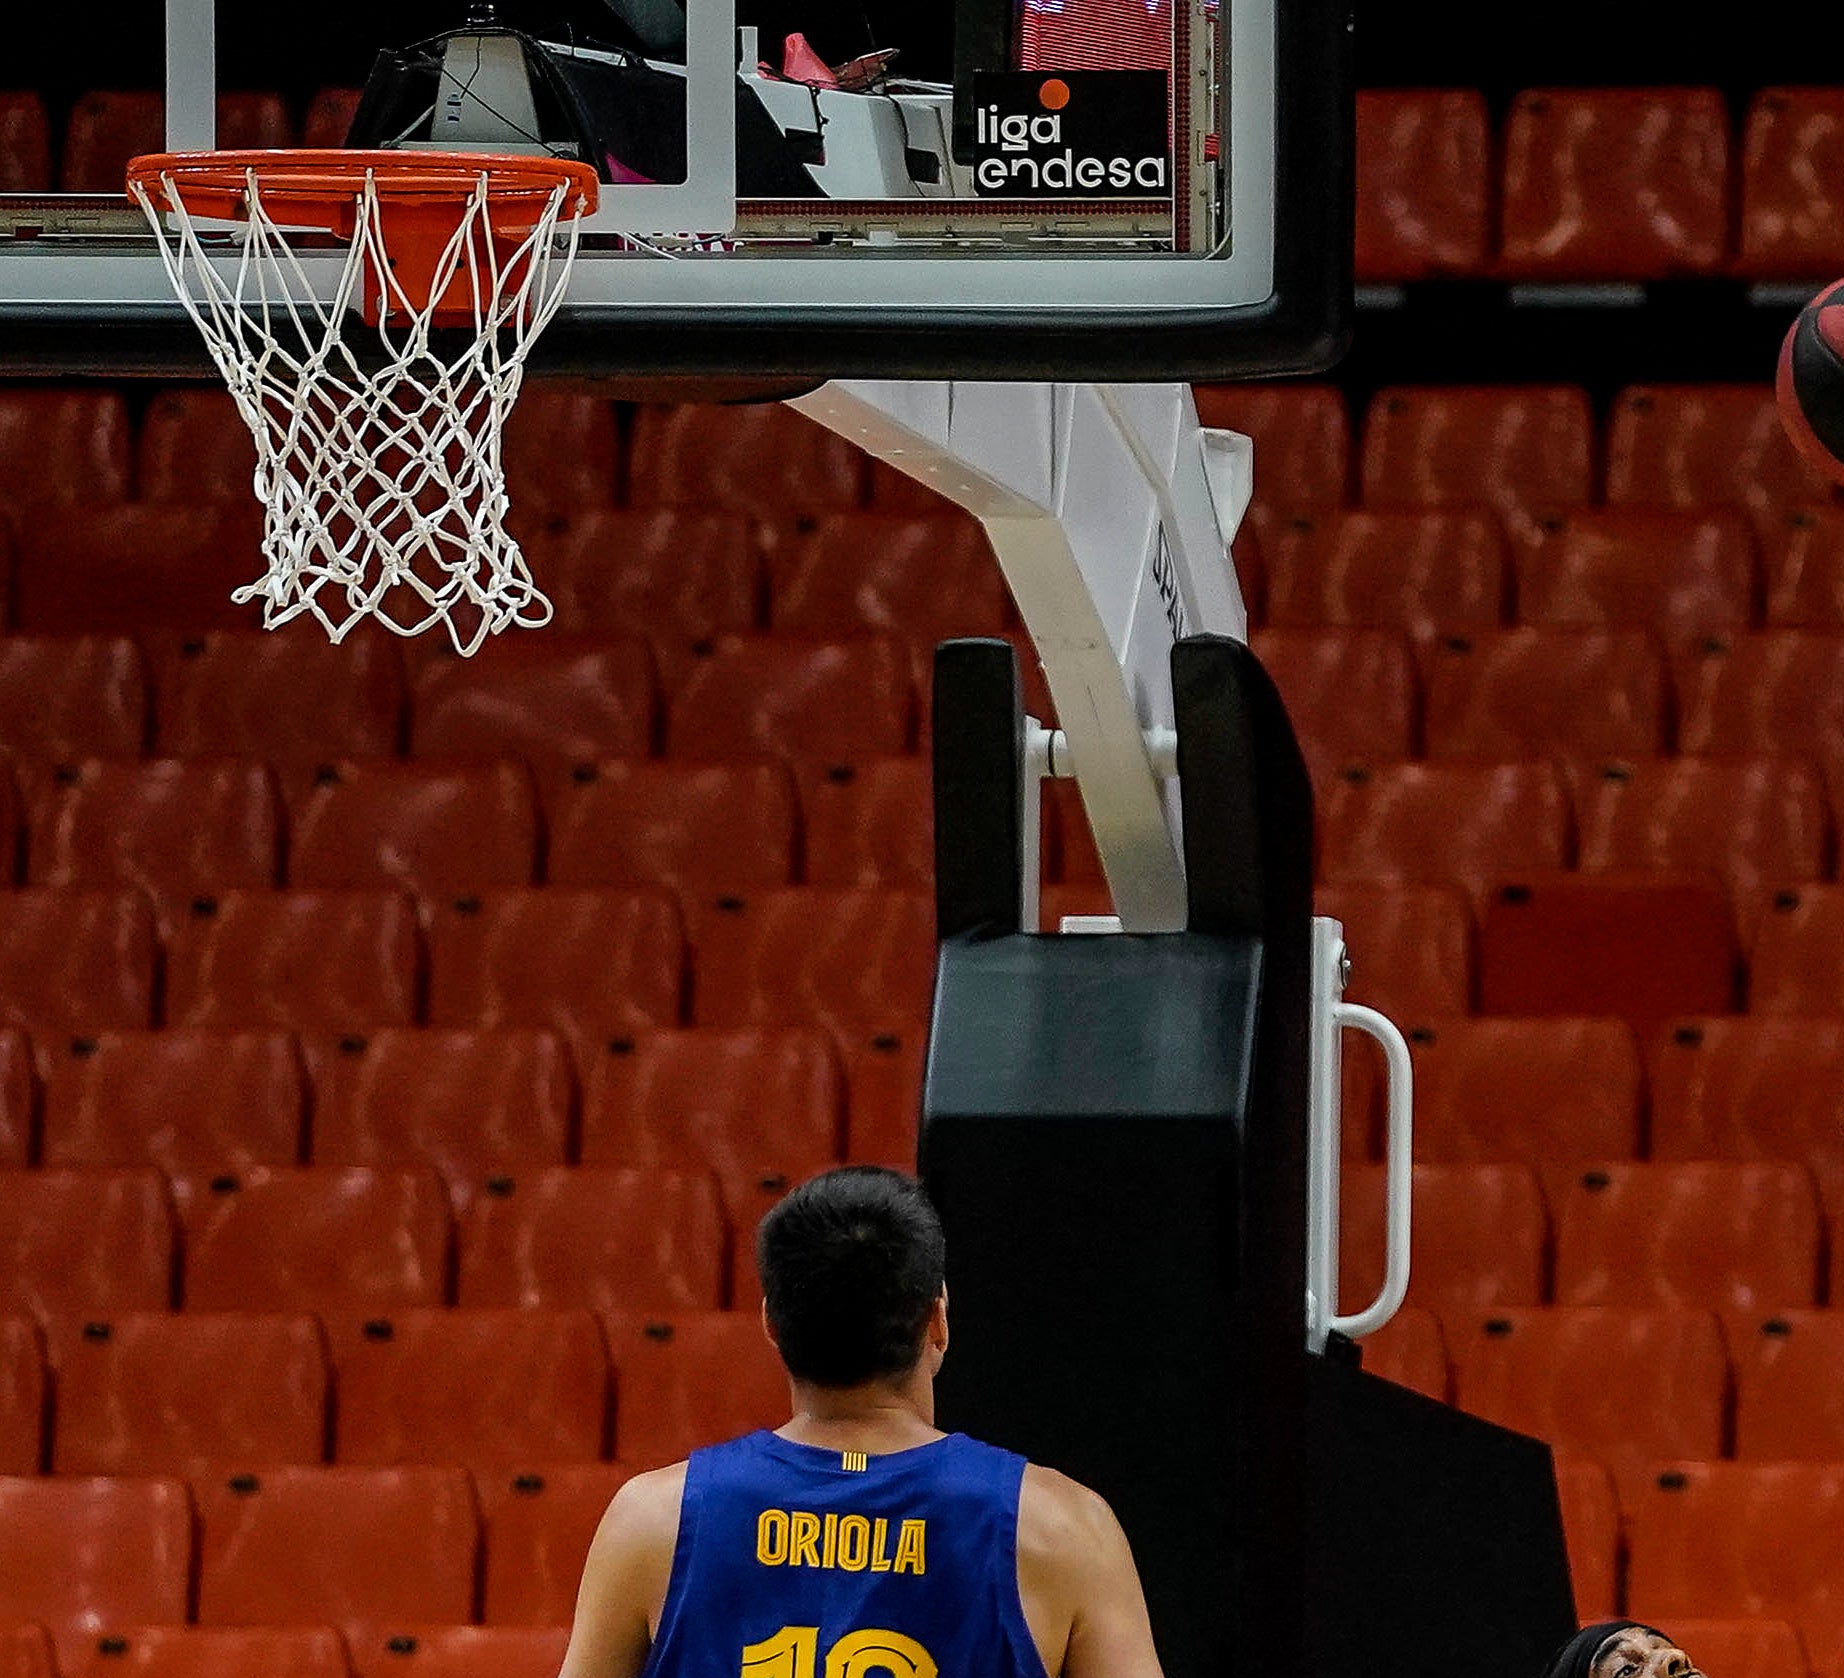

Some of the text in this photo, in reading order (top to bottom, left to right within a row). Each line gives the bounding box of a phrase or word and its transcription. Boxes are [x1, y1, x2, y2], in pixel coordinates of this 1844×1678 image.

[978, 104, 1061, 151] liga
[978, 149, 1165, 188] endesa
[757, 1509, 926, 1575] ORIOLA
